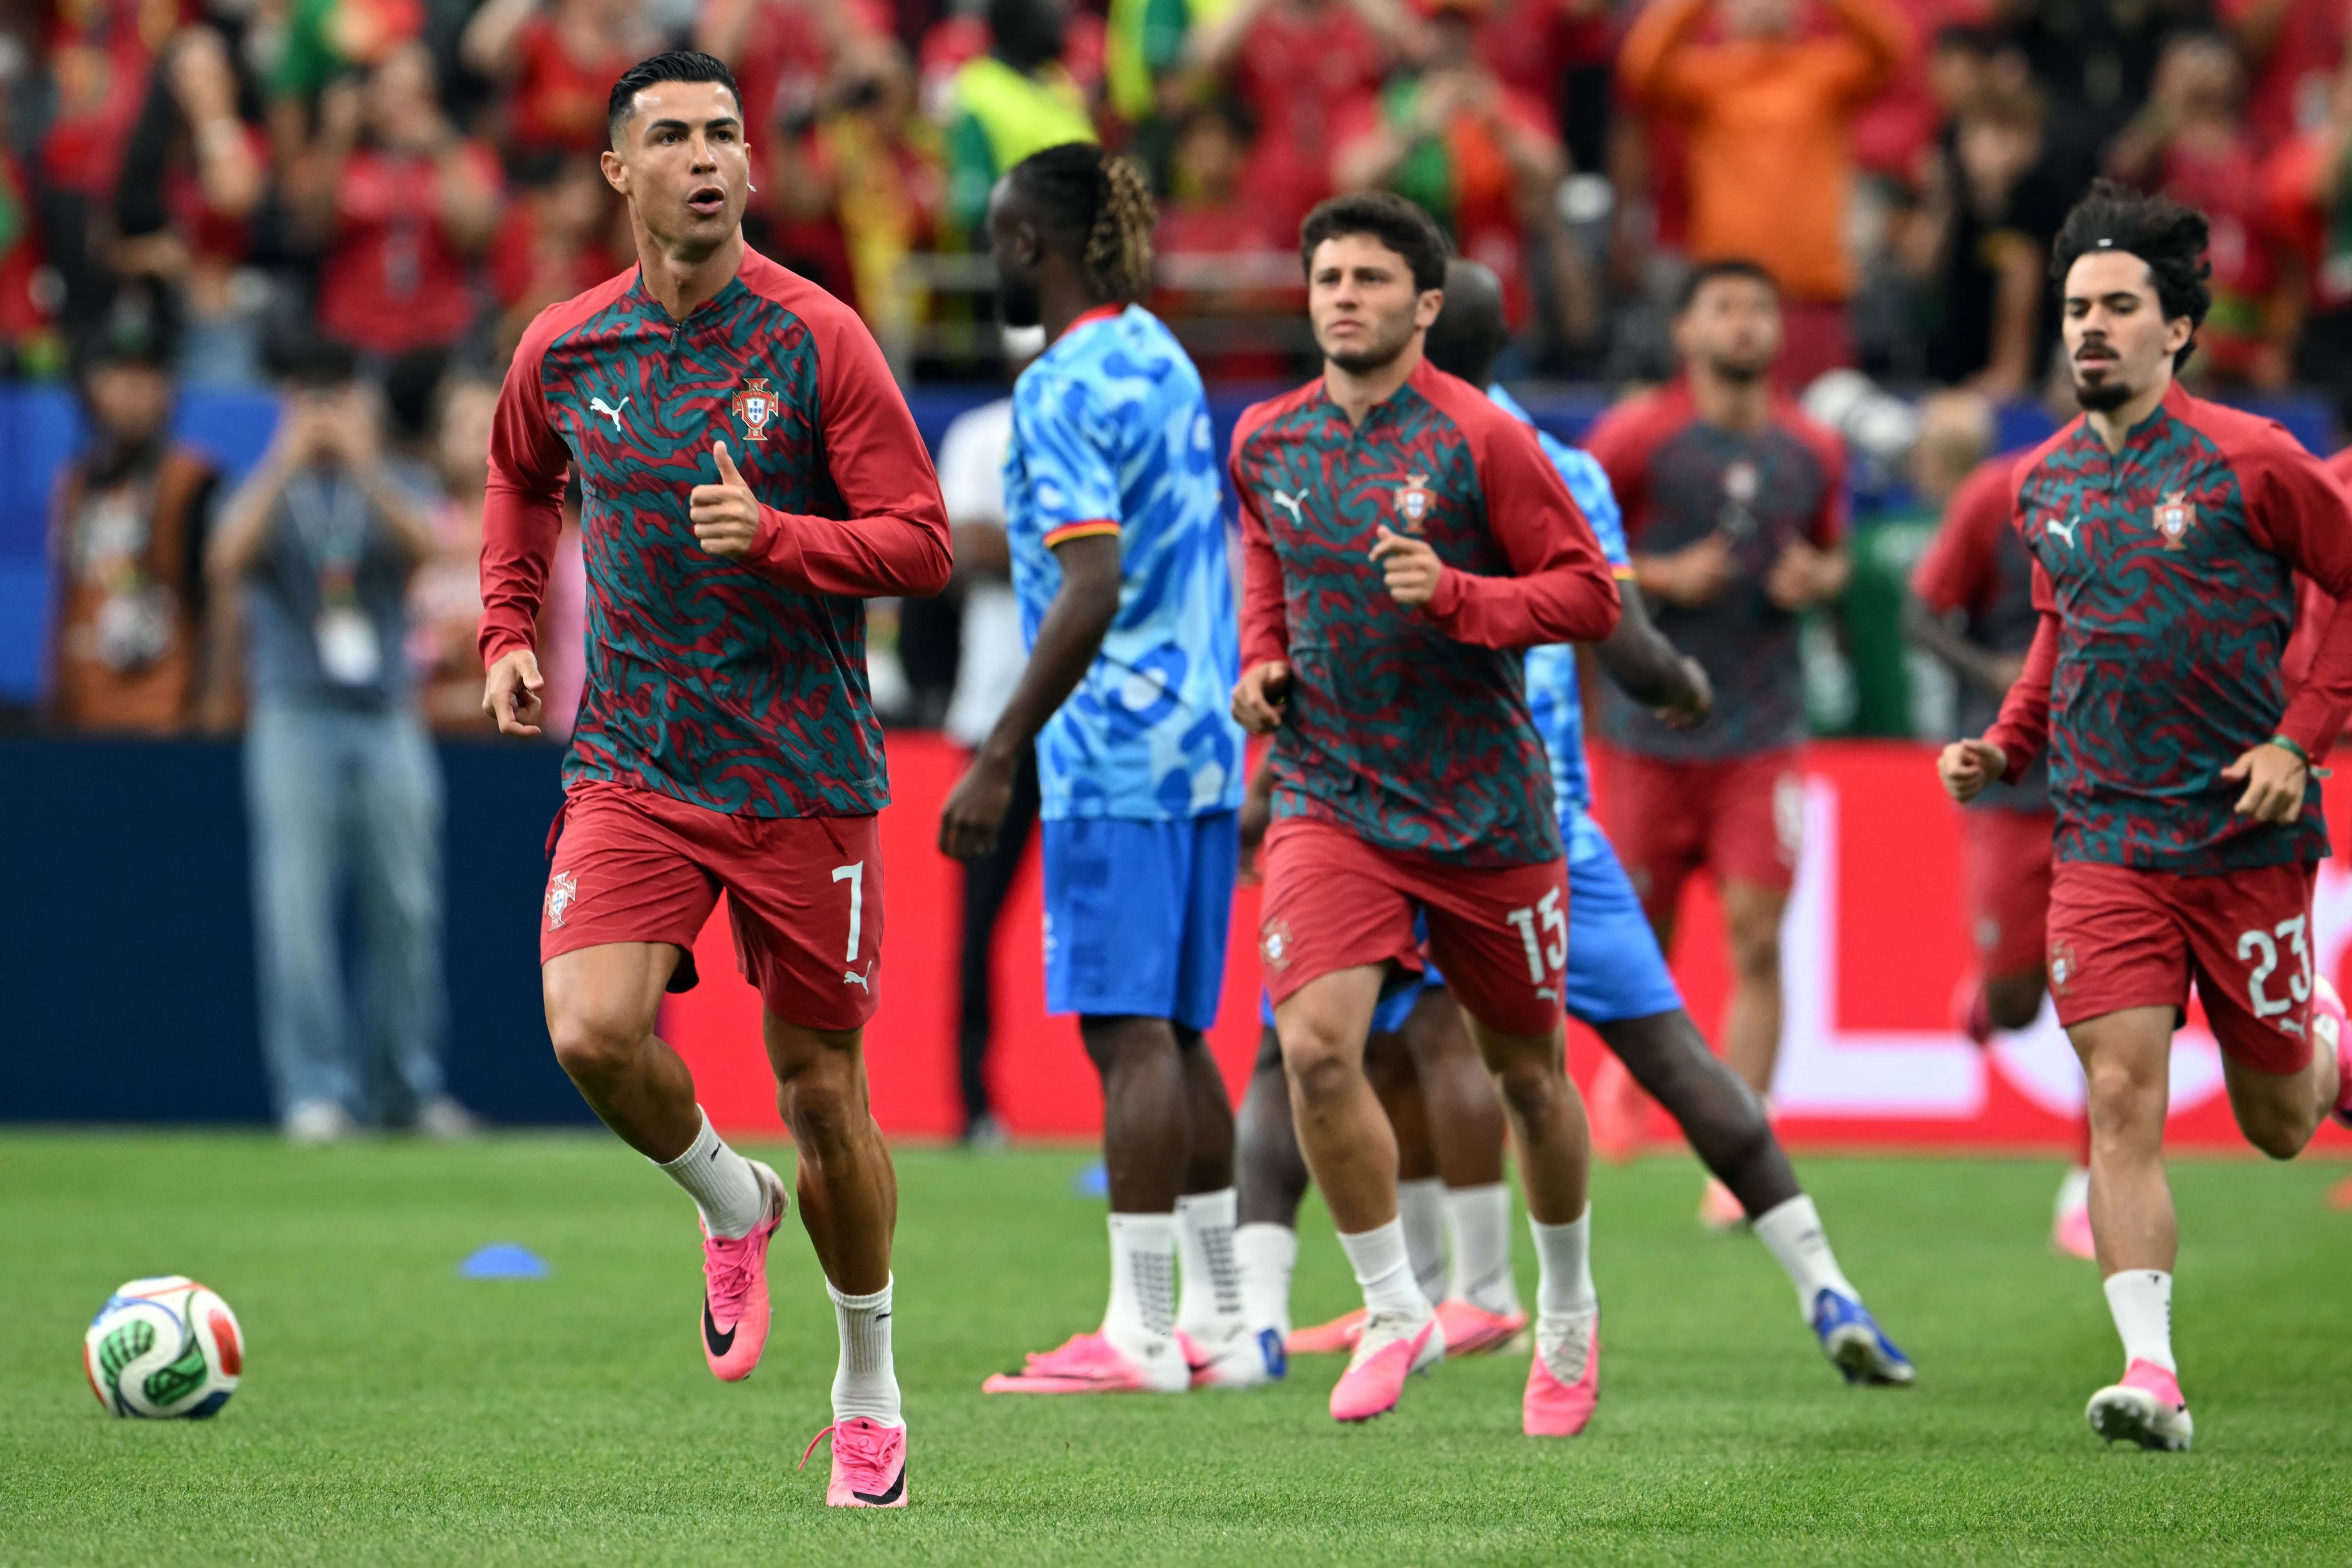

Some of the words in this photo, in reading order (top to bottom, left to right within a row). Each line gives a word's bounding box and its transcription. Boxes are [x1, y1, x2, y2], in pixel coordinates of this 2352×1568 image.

[831, 860, 863, 963] 7
[1507, 886, 1567, 983] 15
[2237, 915, 2313, 1018] 23
